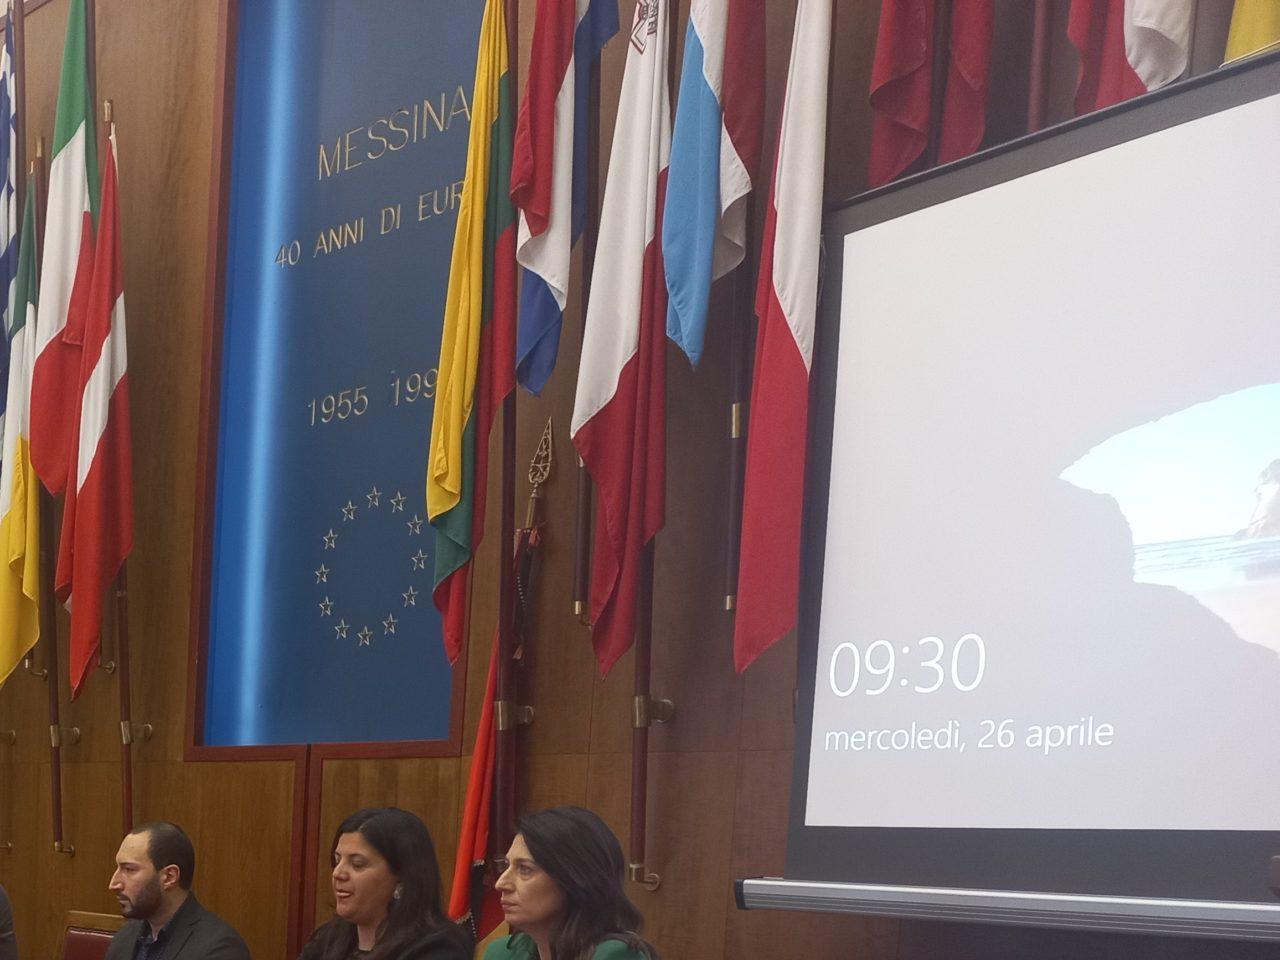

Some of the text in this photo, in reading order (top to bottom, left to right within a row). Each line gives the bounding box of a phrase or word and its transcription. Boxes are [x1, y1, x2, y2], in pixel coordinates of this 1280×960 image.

[318, 85, 471, 181] MESSINA
[274, 180, 465, 268] 40 ANNI DI EUR
[308, 368, 438, 426] 1955 199
[829, 633, 986, 697] 09:30
[824, 716, 1114, 755] mercoledì, 26 aprile
